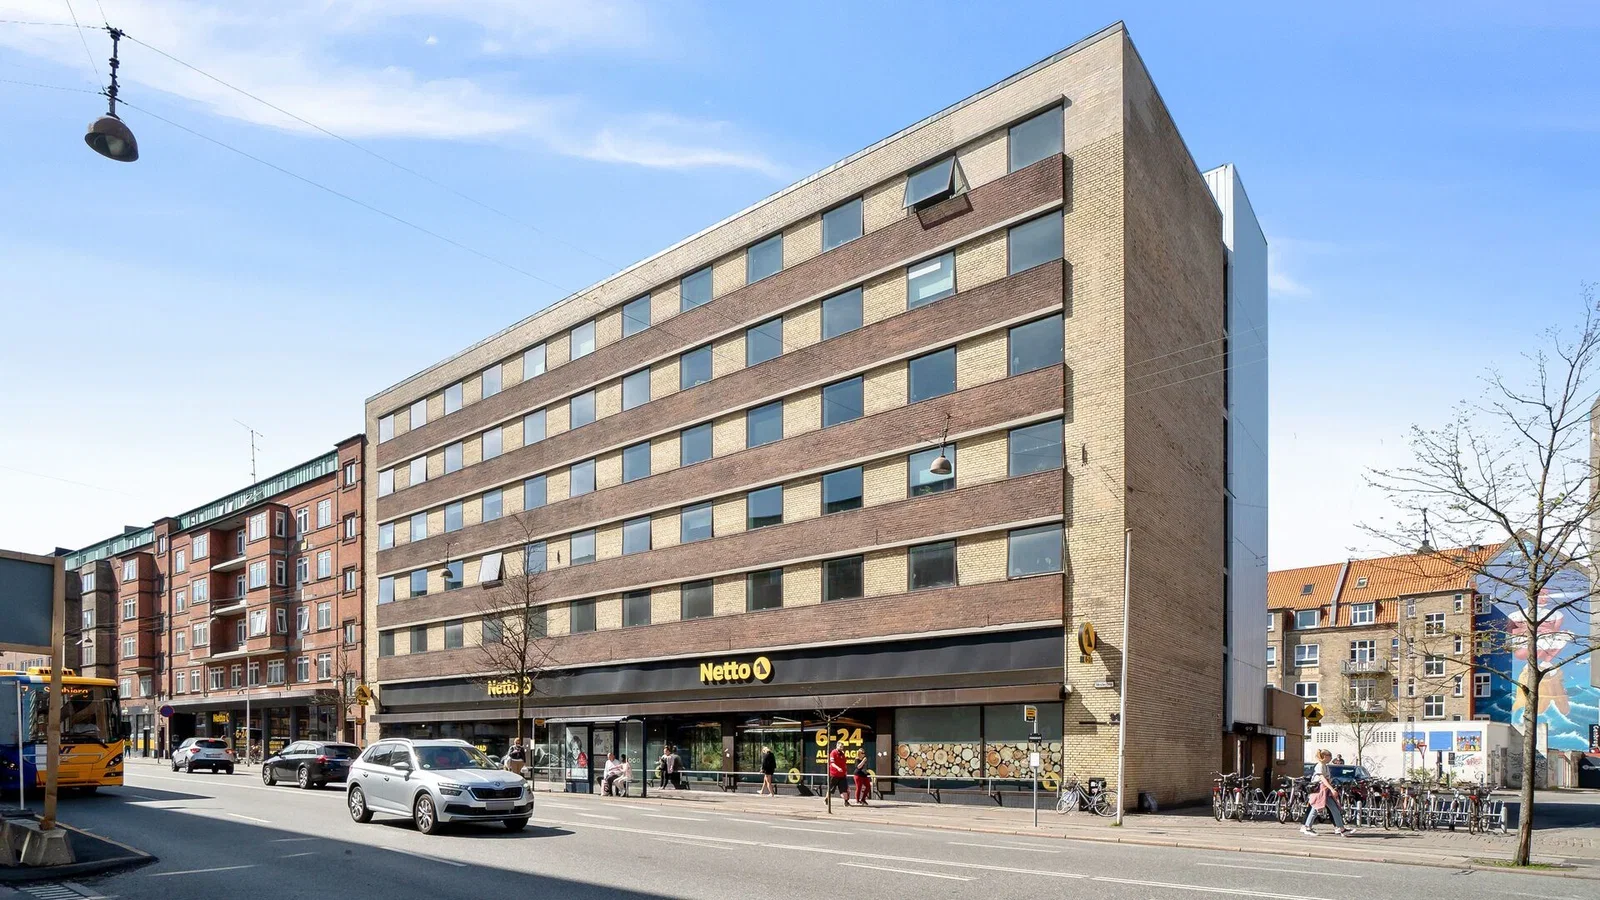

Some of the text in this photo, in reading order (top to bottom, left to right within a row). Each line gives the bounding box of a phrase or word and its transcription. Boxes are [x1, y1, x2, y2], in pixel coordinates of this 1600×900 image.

[700, 661, 751, 682] Netto
[487, 679, 519, 695] Netto
[815, 728, 864, 747] 6-24
